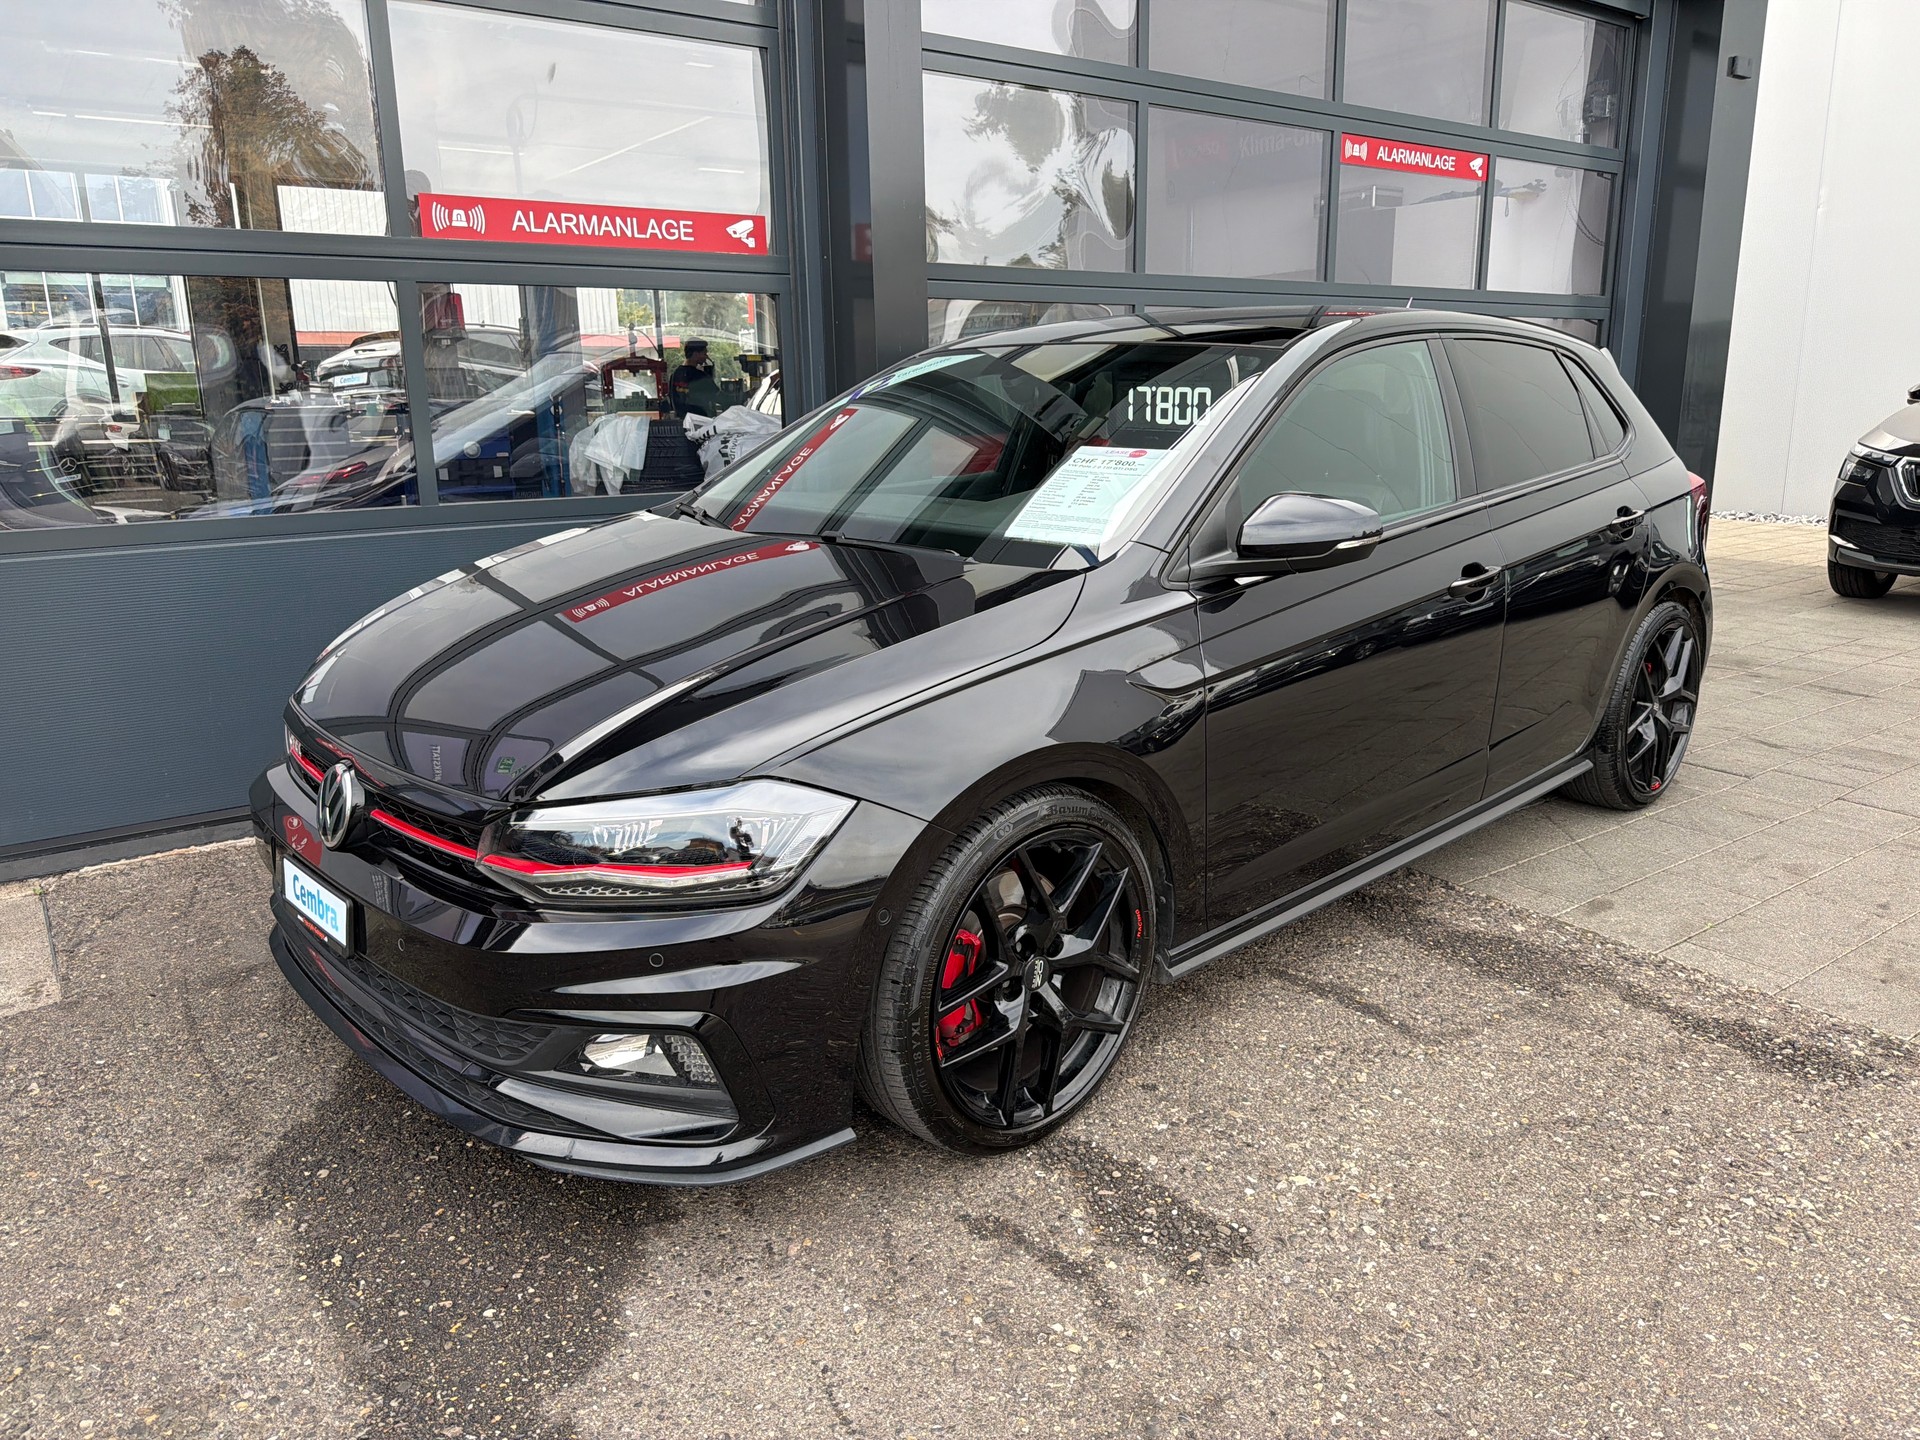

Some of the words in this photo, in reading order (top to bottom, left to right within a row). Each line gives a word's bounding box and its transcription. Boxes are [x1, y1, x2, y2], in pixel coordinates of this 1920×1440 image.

[1376, 145, 1456, 171] ALARMANLAGE
[512, 209, 695, 242] ALARMANLAGE
[1046, 804, 1090, 817] Barum
[293, 874, 339, 932] Cembra
[1134, 908, 1143, 939] RACING
[911, 1018, 921, 1038] XL
